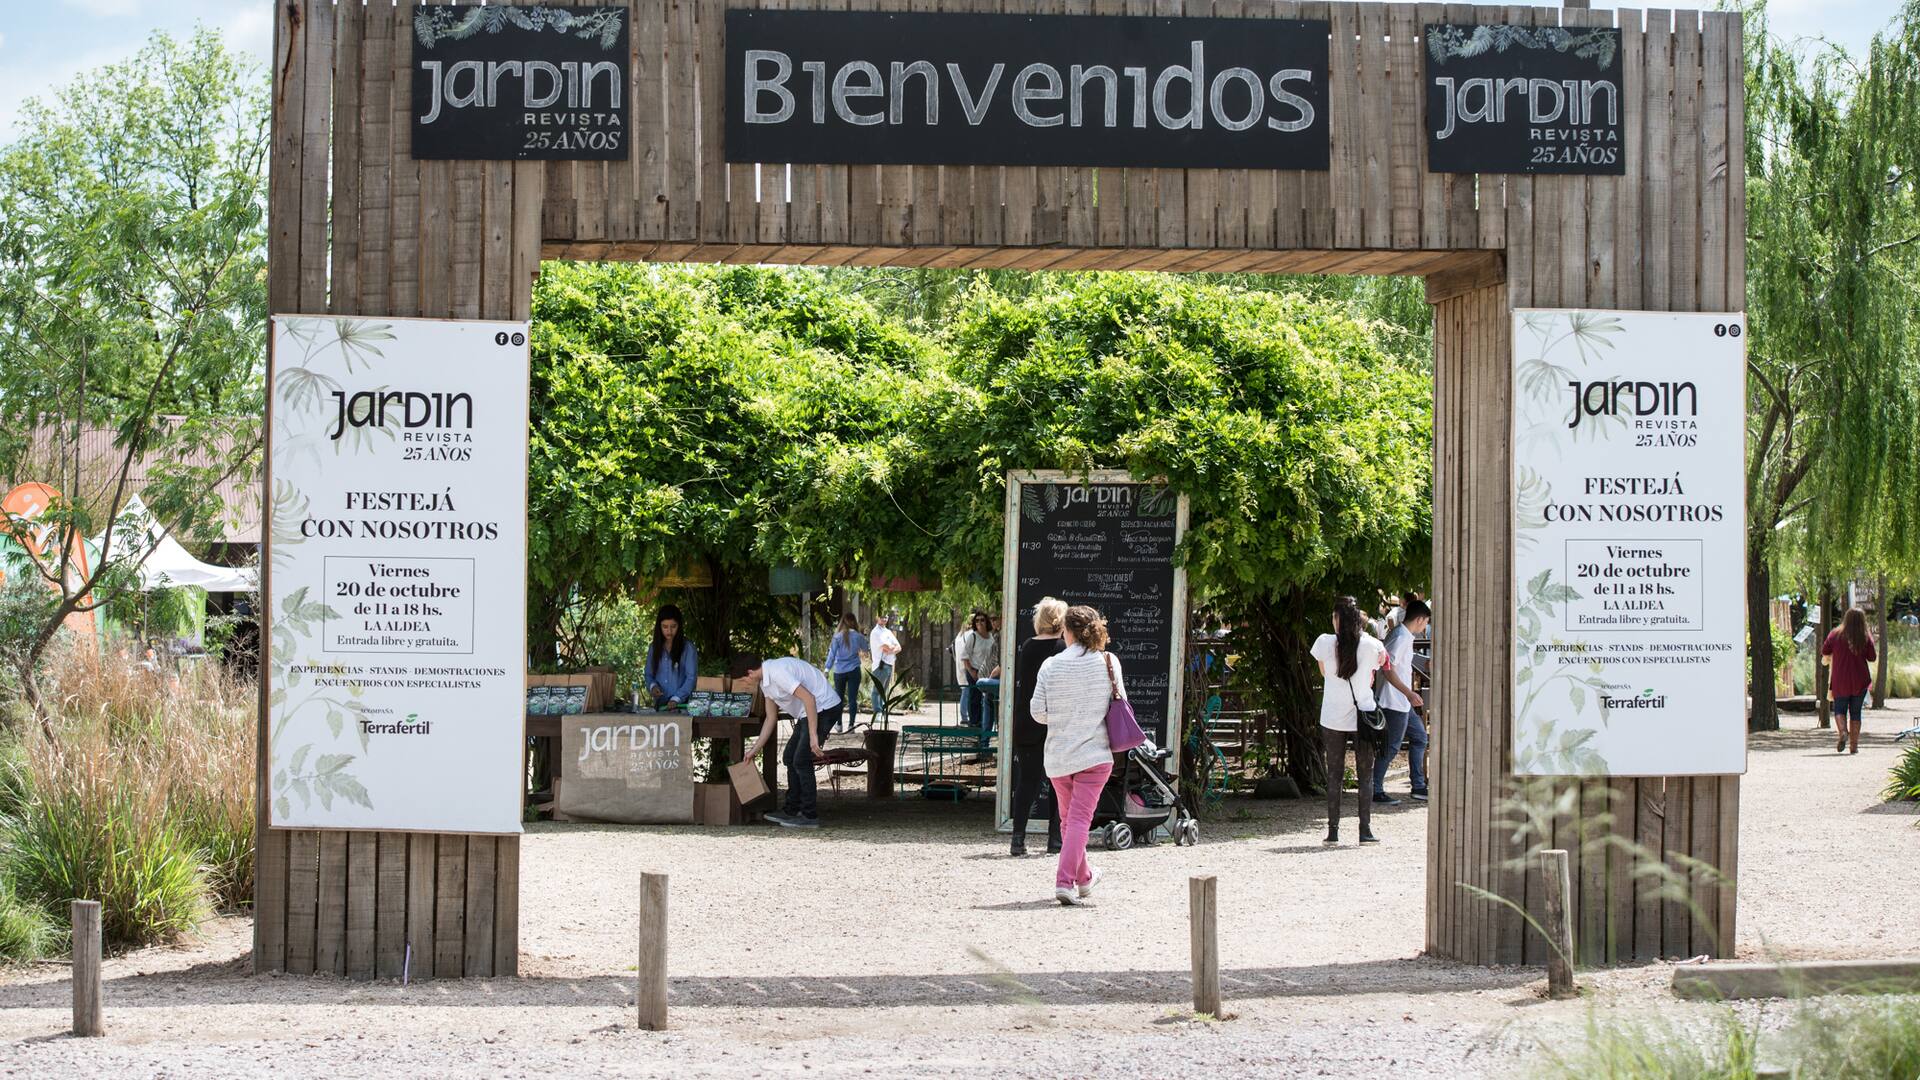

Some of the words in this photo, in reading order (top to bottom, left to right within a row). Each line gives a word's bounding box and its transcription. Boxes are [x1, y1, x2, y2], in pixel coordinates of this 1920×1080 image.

[524, 113, 621, 126] REVISTA
[523, 131, 552, 149] 25
[552, 127, 621, 150] AÑOS
[1531, 129, 1617, 141] REVISTA
[1530, 147, 1557, 163] 25
[1557, 143, 1617, 164] AÑOS
[1635, 420, 1697, 430] REVISTA
[403, 432, 472, 443] REVISTA
[1635, 434, 1653, 447] 25
[1654, 431, 1697, 448] AÑOS
[403, 447, 423, 461] 25
[424, 444, 472, 462] AÑOS
[1584, 472, 1684, 495] FESTEJÁ
[345, 487, 456, 512] FESTEJÁ
[1543, 504, 1592, 522] CON
[1599, 504, 1723, 522] NOSOTROS
[301, 519, 353, 538] CON
[361, 520, 498, 540] NOSOTROS
[1607, 545, 1663, 559] Viernes
[369, 563, 430, 578] Viernes
[1577, 563, 1600, 578] 20
[1603, 563, 1623, 578] de
[1626, 563, 1690, 578] octubre
[336, 581, 360, 597] 20
[365, 582, 386, 598] de
[390, 582, 461, 599] octubre
[1593, 583, 1610, 595] de
[1613, 583, 1624, 595] 11
[1628, 586, 1636, 595] a
[1639, 583, 1653, 595] 18
[1656, 583, 1675, 595] hs.
[354, 602, 372, 615] de
[375, 602, 388, 615] 11
[391, 606, 400, 616] a
[403, 603, 419, 616] 18
[422, 603, 443, 616] hs.
[1603, 600, 1620, 610] LA
[1621, 600, 1664, 610] ALDEA
[364, 621, 382, 632] LA
[384, 621, 431, 633] ALDEA
[1578, 614, 1618, 625] Entrada
[1619, 614, 1642, 625] libre
[1642, 617, 1649, 626] y
[1650, 614, 1690, 626] gratuita.
[337, 635, 379, 646] Entrada
[381, 635, 406, 647] libre
[407, 638, 415, 649] y
[415, 636, 459, 648] gratuita.
[1536, 644, 1603, 652] EXPERIENCIAS
[1609, 644, 1644, 652] STANDS
[1649, 643, 1733, 652] DEMOSTRACIONES
[1558, 656, 1621, 665] ENCUENTROS
[1622, 656, 1641, 665] CON
[1643, 655, 1711, 664] ESPECIALISTAS
[290, 665, 364, 675] EXPERIENCIAS
[369, 666, 408, 675] STANDS
[414, 667, 506, 677] DEMOSTRACIONES
[314, 678, 383, 688] ENCUENTROS
[384, 679, 404, 688] CON
[406, 679, 481, 689] ESPECIALISTAS
[1600, 696, 1665, 709] Terrafertil
[360, 720, 430, 735] Terrafertil
[631, 749, 680, 759] REVISTA
